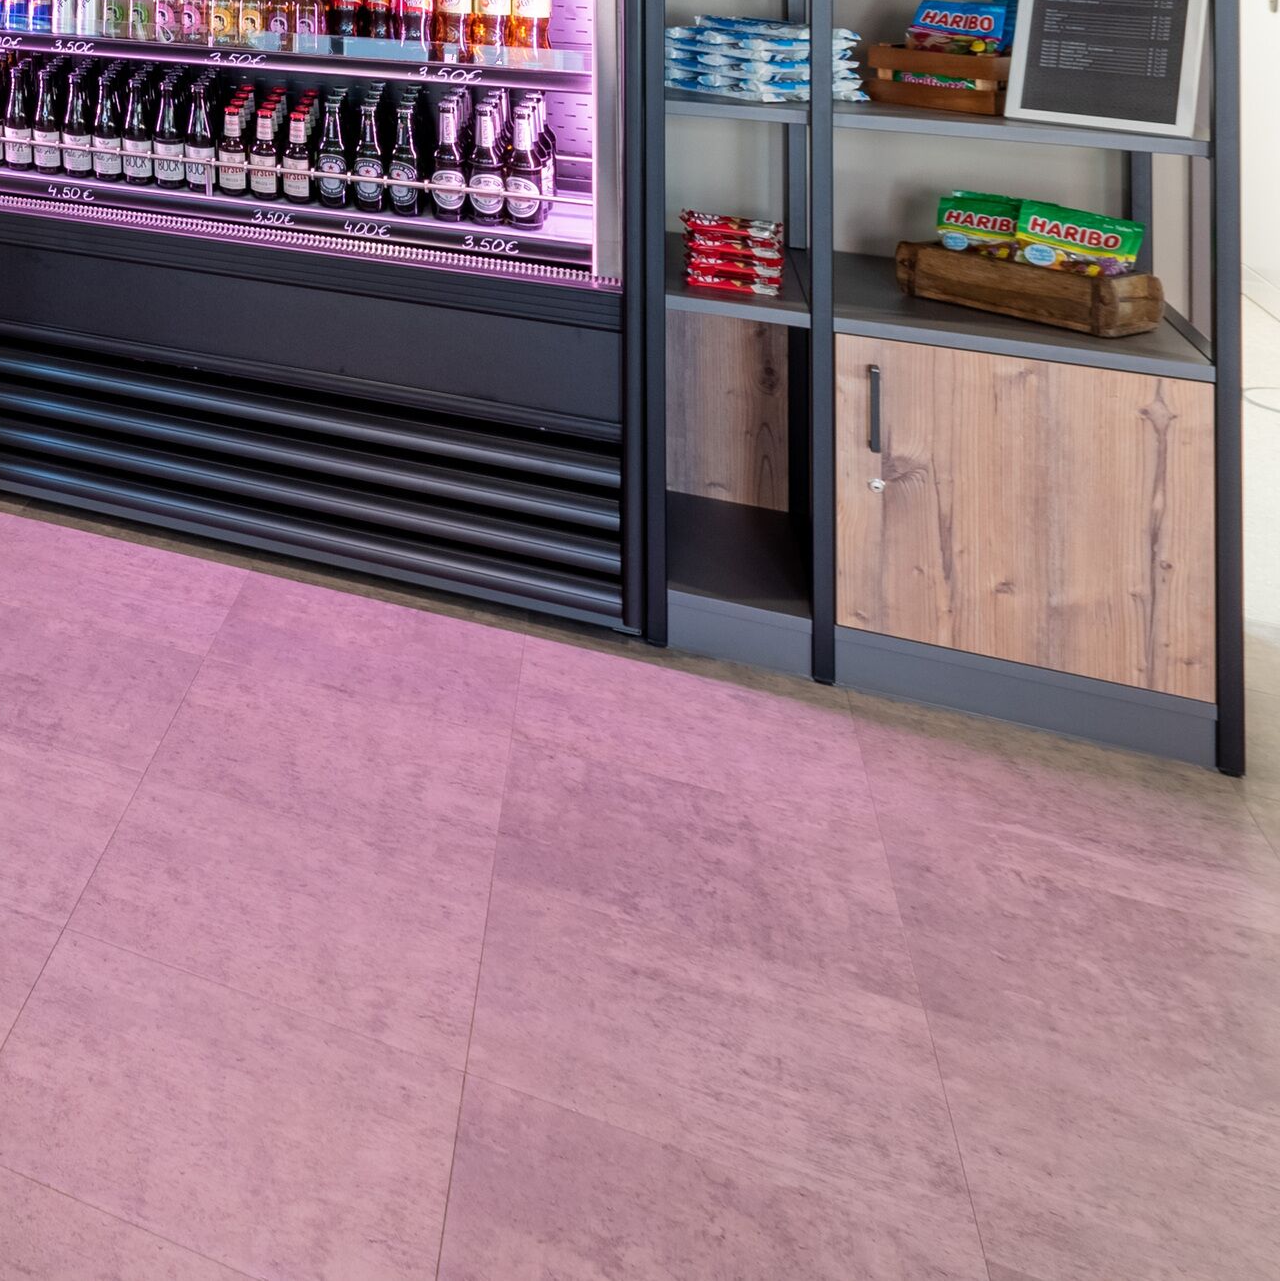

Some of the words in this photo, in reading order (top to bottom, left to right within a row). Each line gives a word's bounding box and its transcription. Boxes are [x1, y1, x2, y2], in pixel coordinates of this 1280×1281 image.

[921, 8, 994, 32] HARIBO
[51, 40, 95, 53] 3.50€
[209, 52, 267, 67] 3.50€
[413, 66, 483, 84] 3.50€
[125, 156, 147, 168] BOCK
[157, 159, 179, 172] BOCK
[188, 163, 207, 176] BOC
[48, 185, 81, 199] 4.50
[83, 189, 95, 201] €
[251, 208, 296, 226] 3.50€
[344, 220, 392, 238] 4.00€
[1029, 215, 1122, 249] HARIBO
[462, 235, 519, 255] 3.50€
